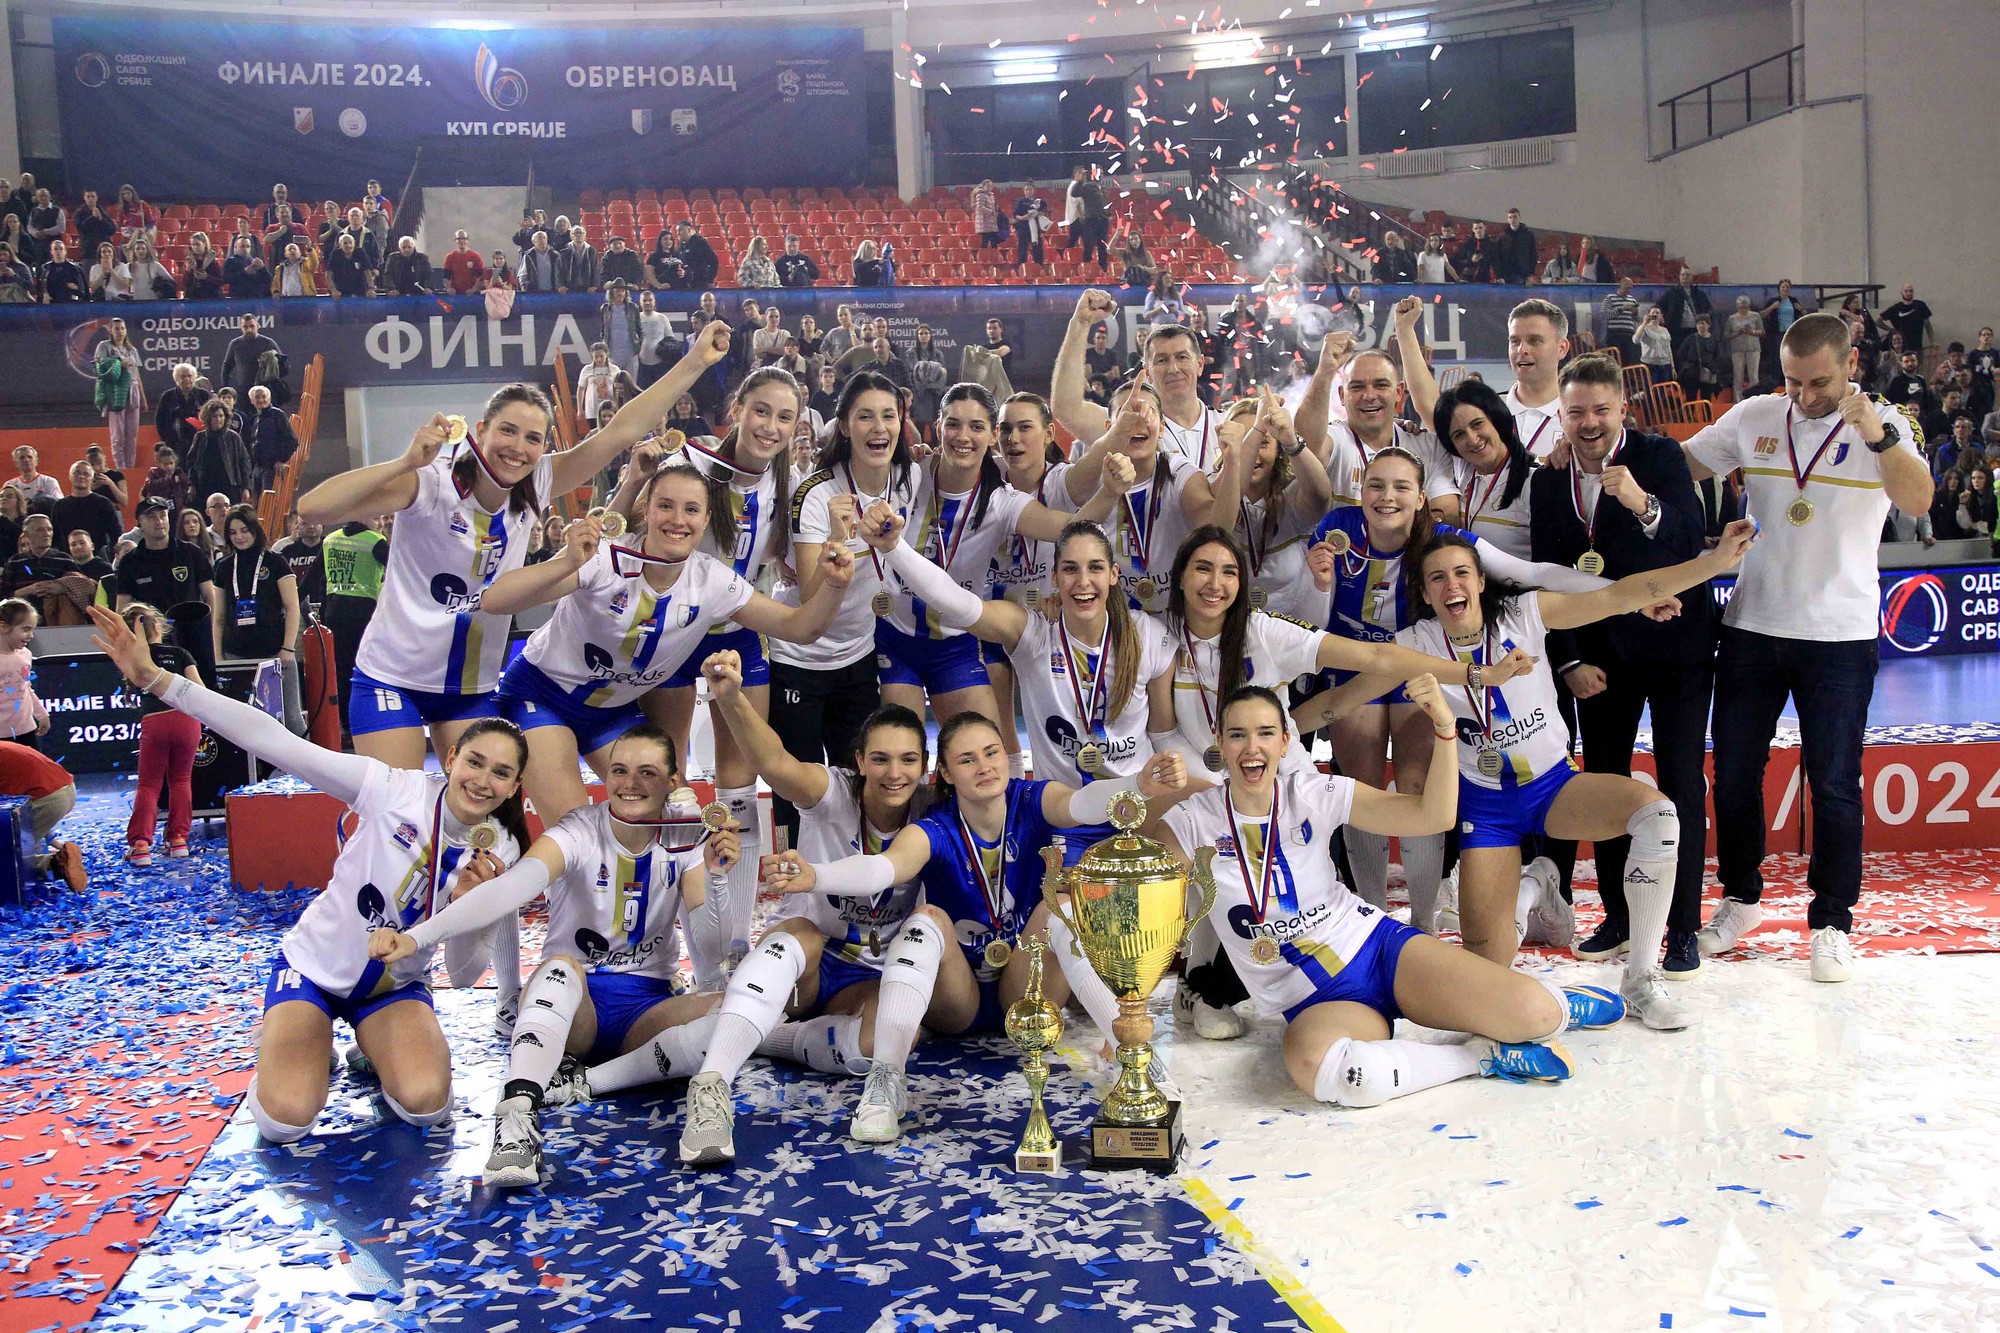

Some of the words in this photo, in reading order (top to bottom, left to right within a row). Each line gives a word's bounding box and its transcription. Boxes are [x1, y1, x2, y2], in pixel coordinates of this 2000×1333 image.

[115, 54, 186, 65] ОДБОЈКАШКИ
[116, 65, 148, 75] САВЕЗ
[218, 60, 345, 86] ФИНАЛЕ
[353, 63, 432, 87] 2024.
[566, 64, 736, 91] ОБРЕНОВАЦ
[117, 77, 153, 86] СРБИЈЕ
[447, 121, 490, 136] КУП
[492, 121, 566, 138] СРБИЈЕ
[888, 317, 920, 326] БАНКА
[889, 328, 949, 337] ПОШТСКА
[143, 337, 200, 351] САВЕЗ
[1754, 435, 1779, 455] MS
[924, 533, 939, 559] 5
[476, 549, 503, 576] 15
[1961, 598, 2000, 617] САВ
[631, 634, 647, 658] 1
[374, 688, 402, 712] 15
[784, 688, 800, 704] TC
[1625, 876, 1659, 885] PEAK
[622, 898, 640, 933] 9
[275, 967, 302, 993] 14
